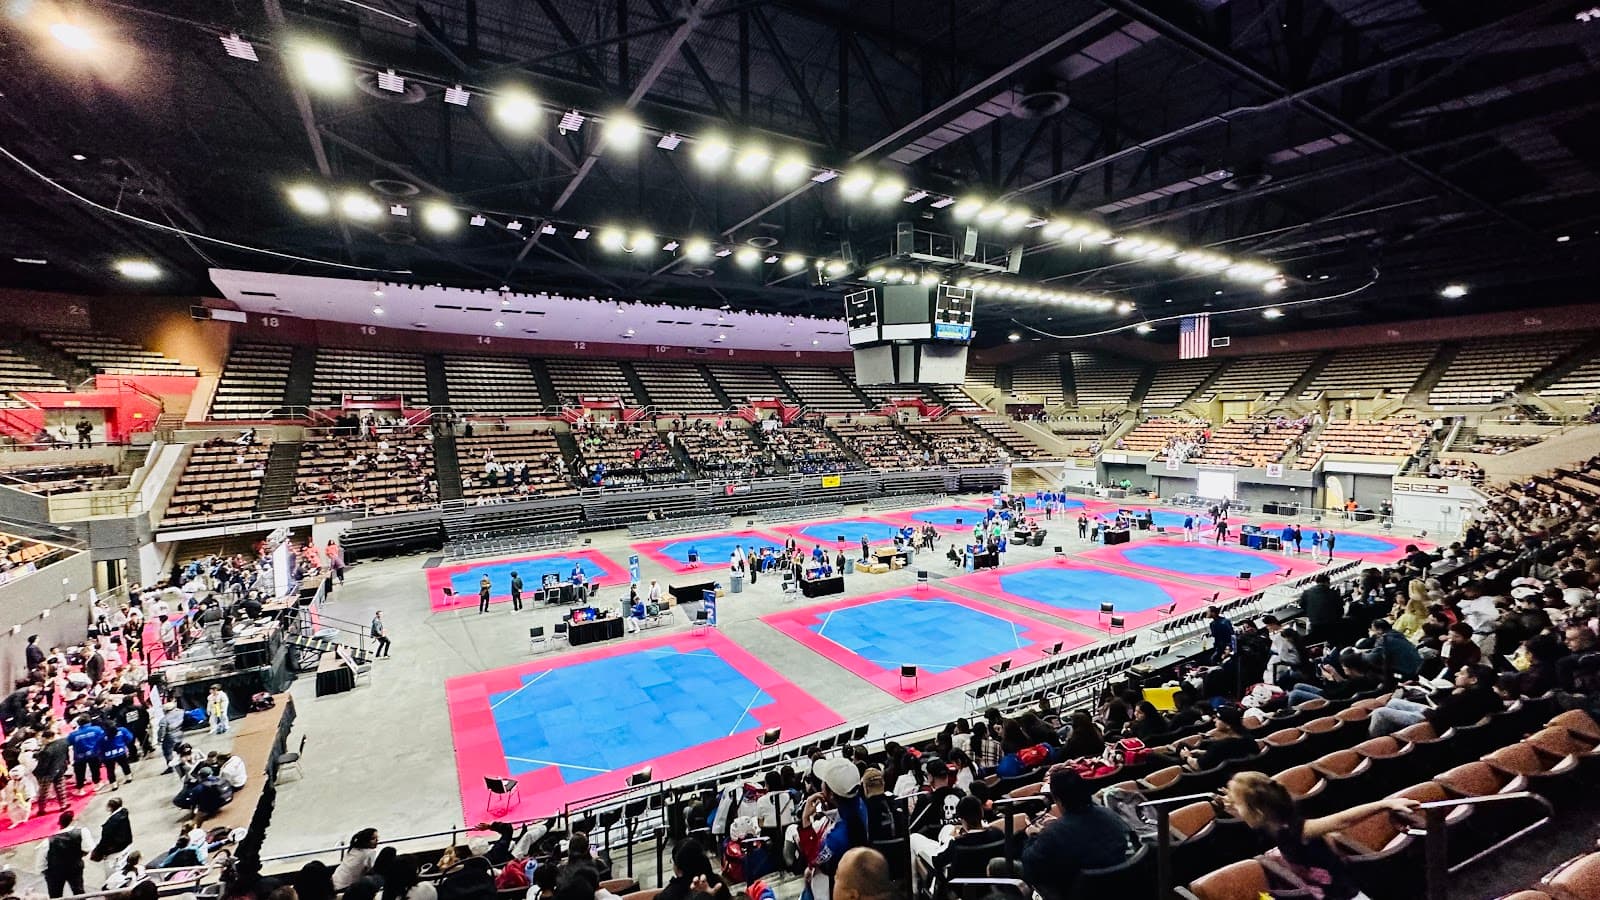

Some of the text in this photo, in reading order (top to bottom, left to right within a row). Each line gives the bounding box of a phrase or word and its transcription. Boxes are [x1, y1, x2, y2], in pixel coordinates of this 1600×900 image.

[261, 316, 280, 328] 18
[360, 326, 376, 336] 16
[477, 336, 491, 345] 14
[573, 342, 586, 350] 12
[655, 345, 667, 353] 10
[104, 747, 125, 757] USA
